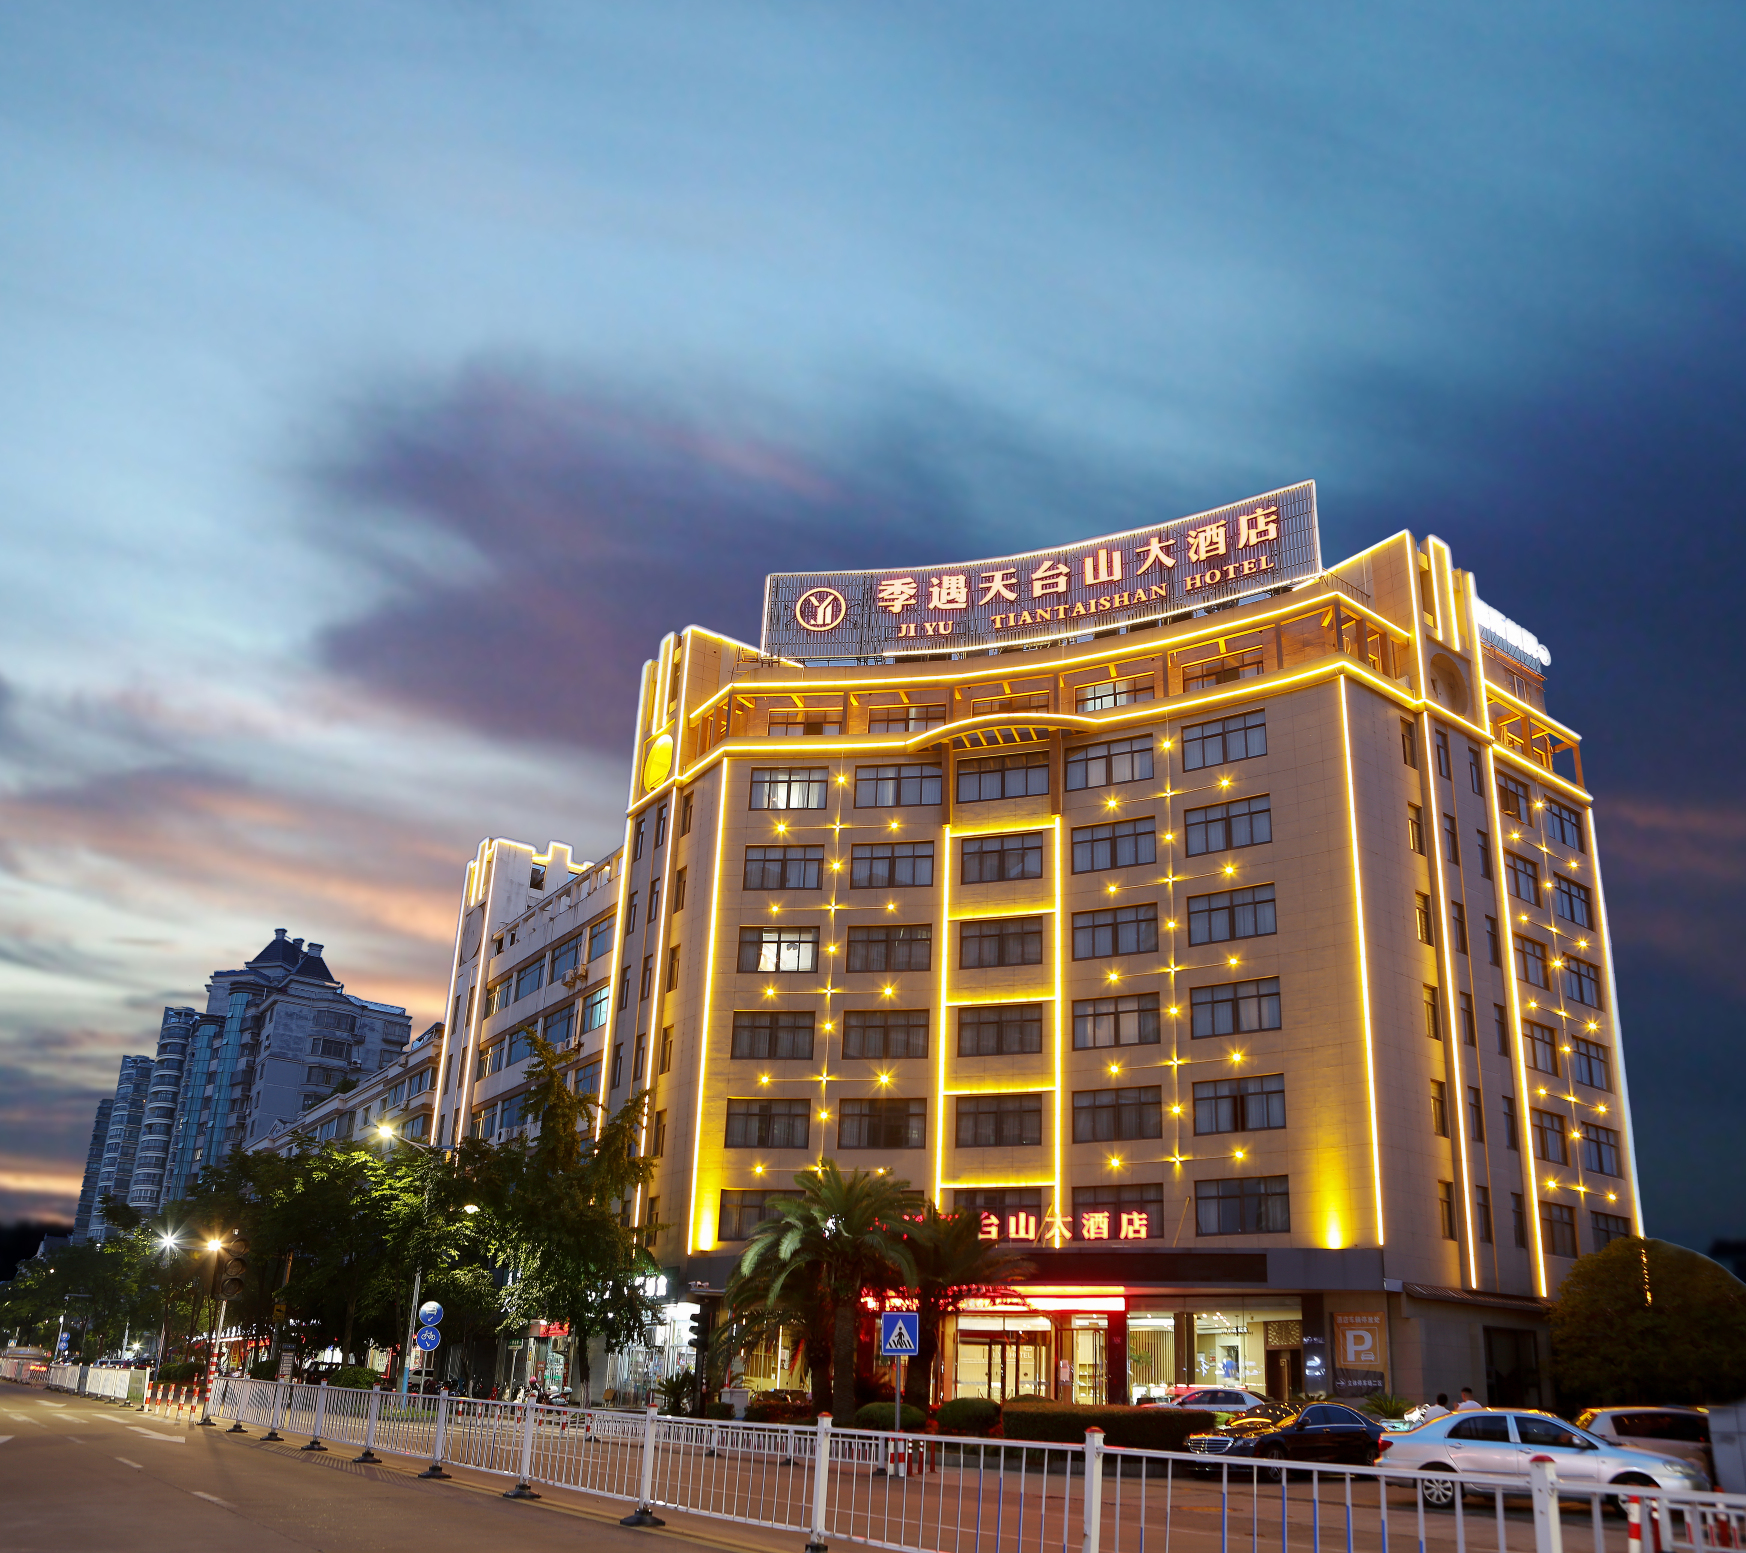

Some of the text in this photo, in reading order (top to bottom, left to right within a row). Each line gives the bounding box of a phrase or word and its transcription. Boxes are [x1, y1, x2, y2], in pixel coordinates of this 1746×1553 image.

[877, 505, 1278, 614] 季遇天台山大酒店
[898, 555, 1275, 637] JI YU TIANTAISHAN HOTEL
[1346, 1330, 1373, 1361] P
